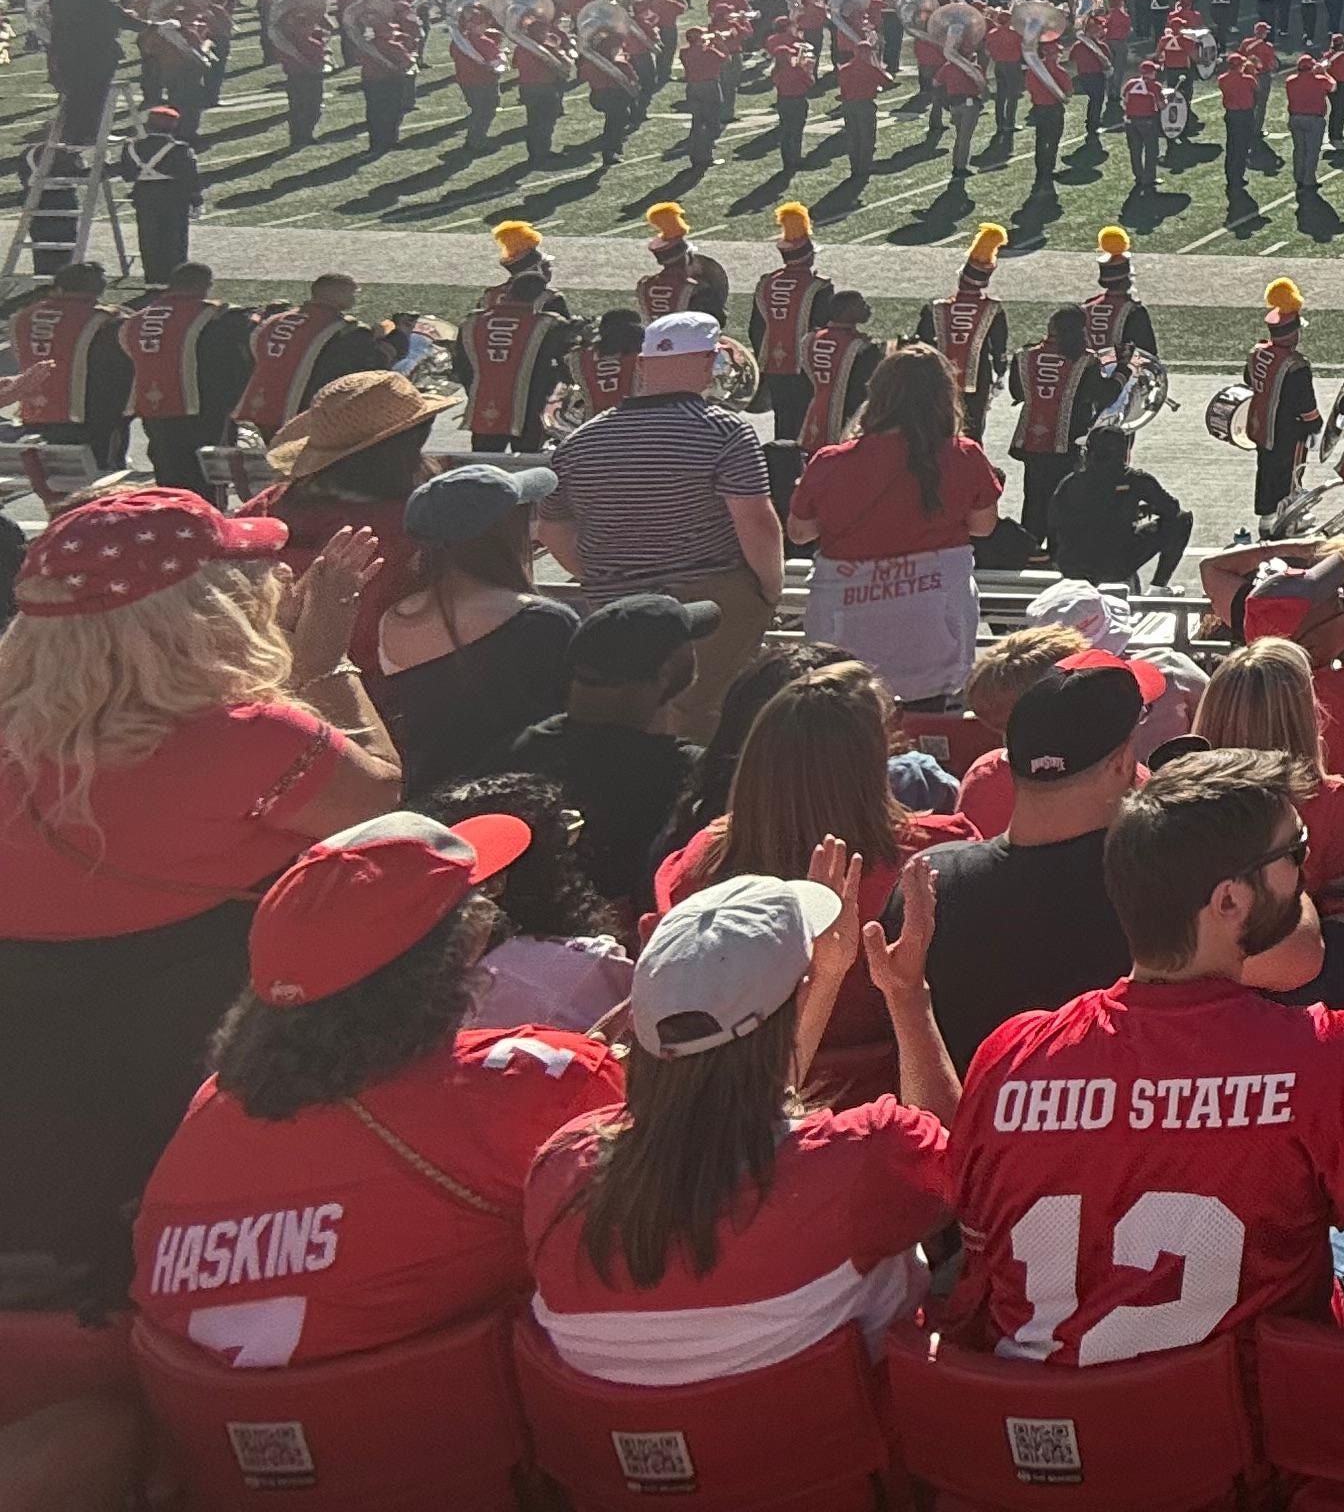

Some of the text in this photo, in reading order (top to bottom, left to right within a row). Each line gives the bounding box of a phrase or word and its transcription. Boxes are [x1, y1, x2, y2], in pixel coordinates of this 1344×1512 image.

[843, 572, 942, 607] BUCKEYES
[993, 1072, 1298, 1133] OHIO STATE
[151, 1202, 344, 1295] HASKINS
[993, 1191, 1246, 1367] 12
[187, 1296, 308, 1368] 7
